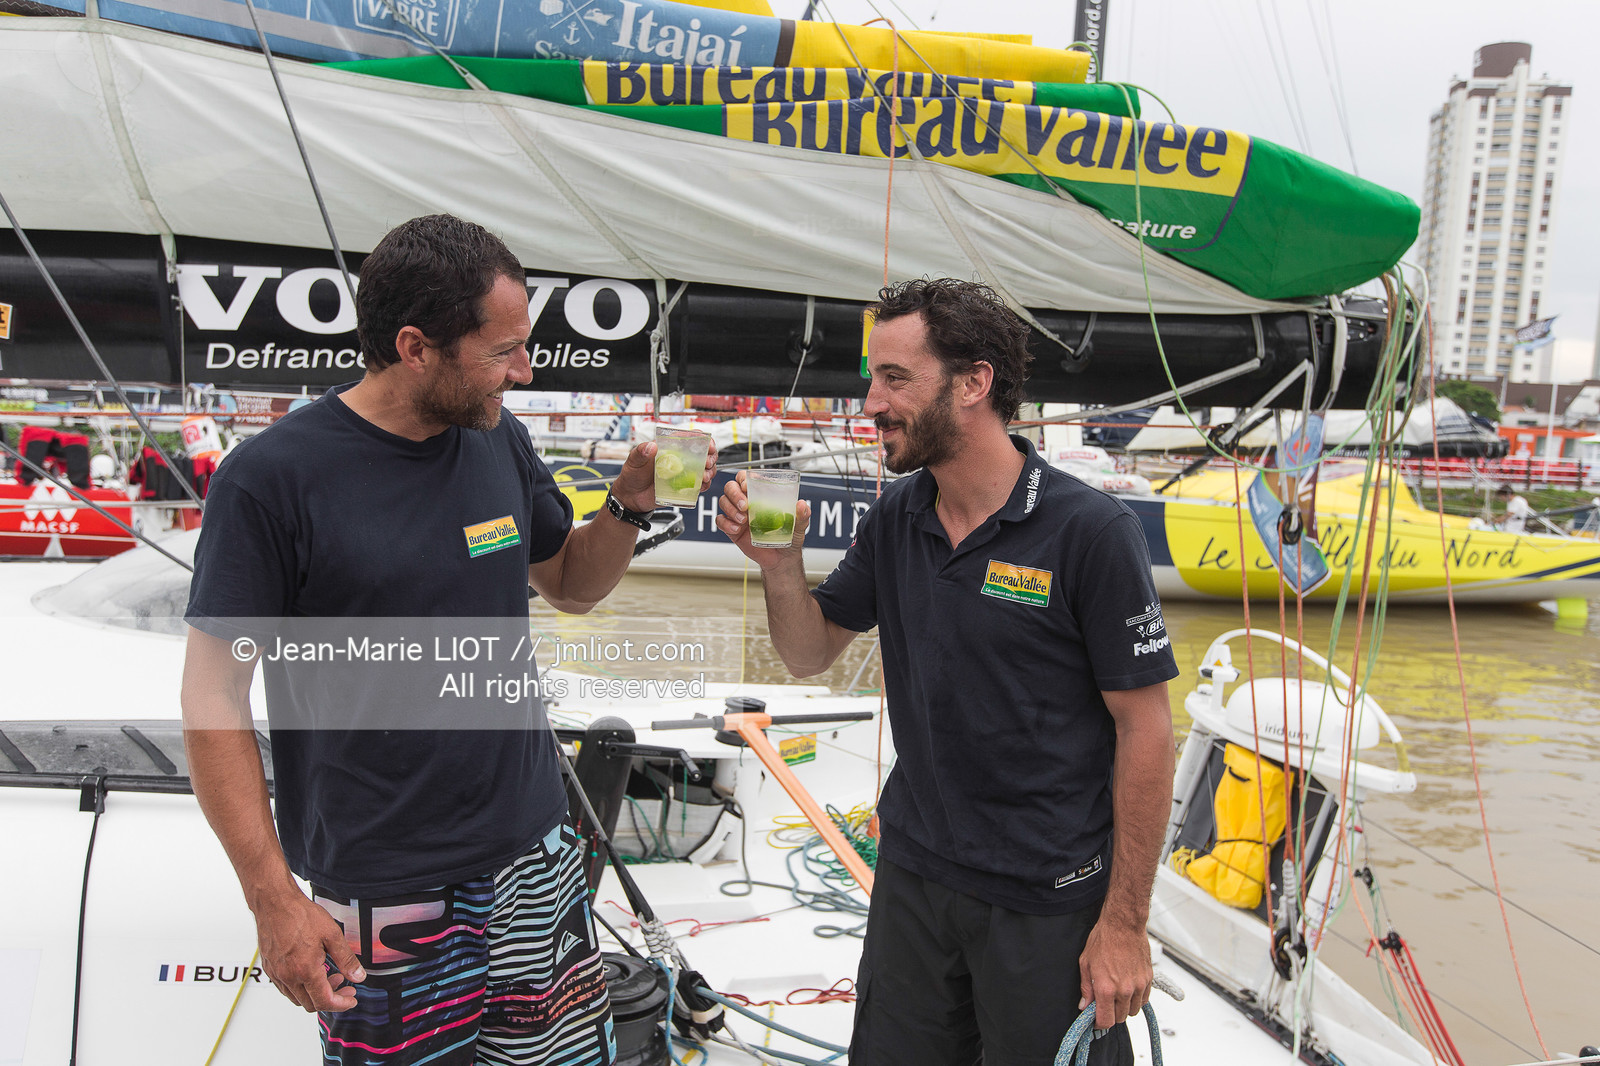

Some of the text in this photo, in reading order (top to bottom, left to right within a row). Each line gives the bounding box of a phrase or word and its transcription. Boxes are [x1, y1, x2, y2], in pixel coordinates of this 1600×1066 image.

[607, 61, 827, 106] Bureau
[753, 97, 1004, 158] Bureau
[20, 520, 80, 534] MACSF
[468, 524, 516, 545] Bureau Vallée
[1198, 536, 1235, 570] Le
[1443, 534, 1521, 569] Nord
[989, 572, 1046, 593] Bureau Vallée
[1265, 723, 1309, 740] iridum
[194, 965, 274, 983] BUR
